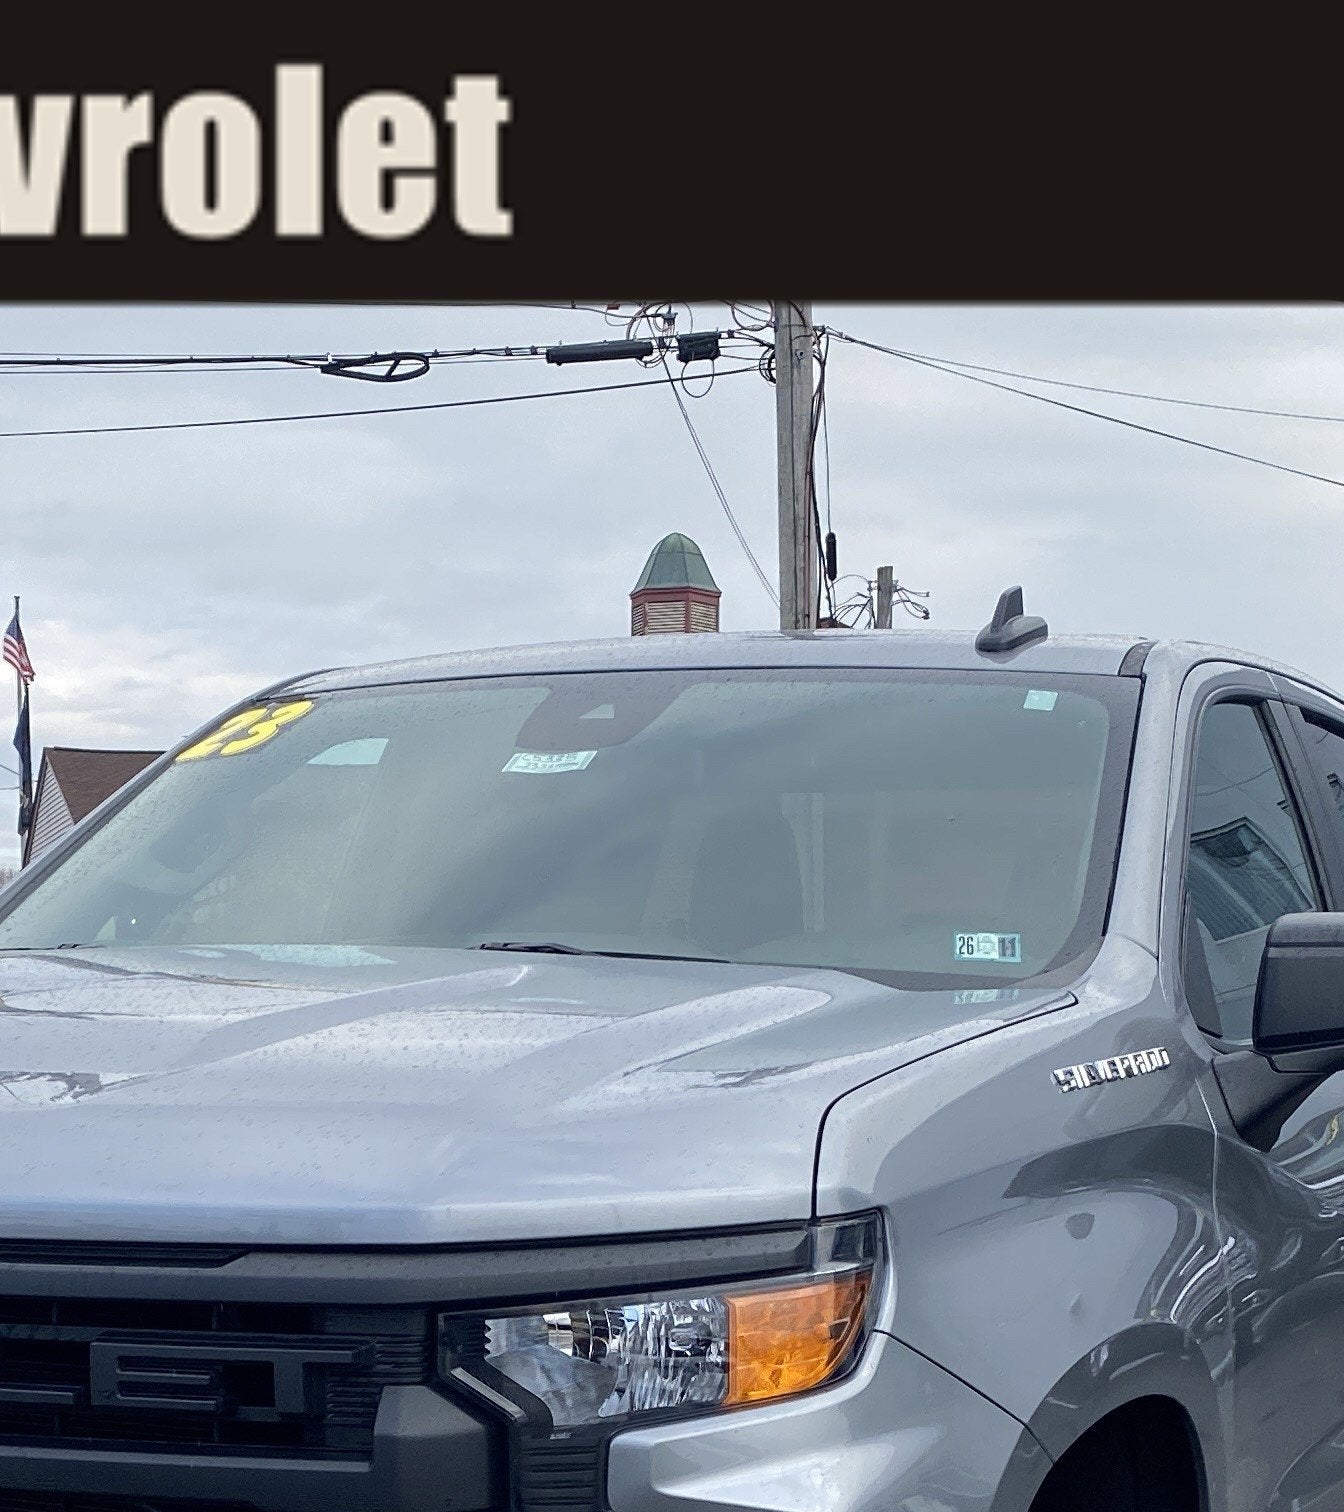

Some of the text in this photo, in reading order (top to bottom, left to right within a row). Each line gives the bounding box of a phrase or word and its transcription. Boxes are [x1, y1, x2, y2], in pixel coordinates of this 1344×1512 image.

[174, 700, 314, 762] 23
[959, 936, 974, 955] 26
[1053, 1047, 1171, 1094] SILVERADO
